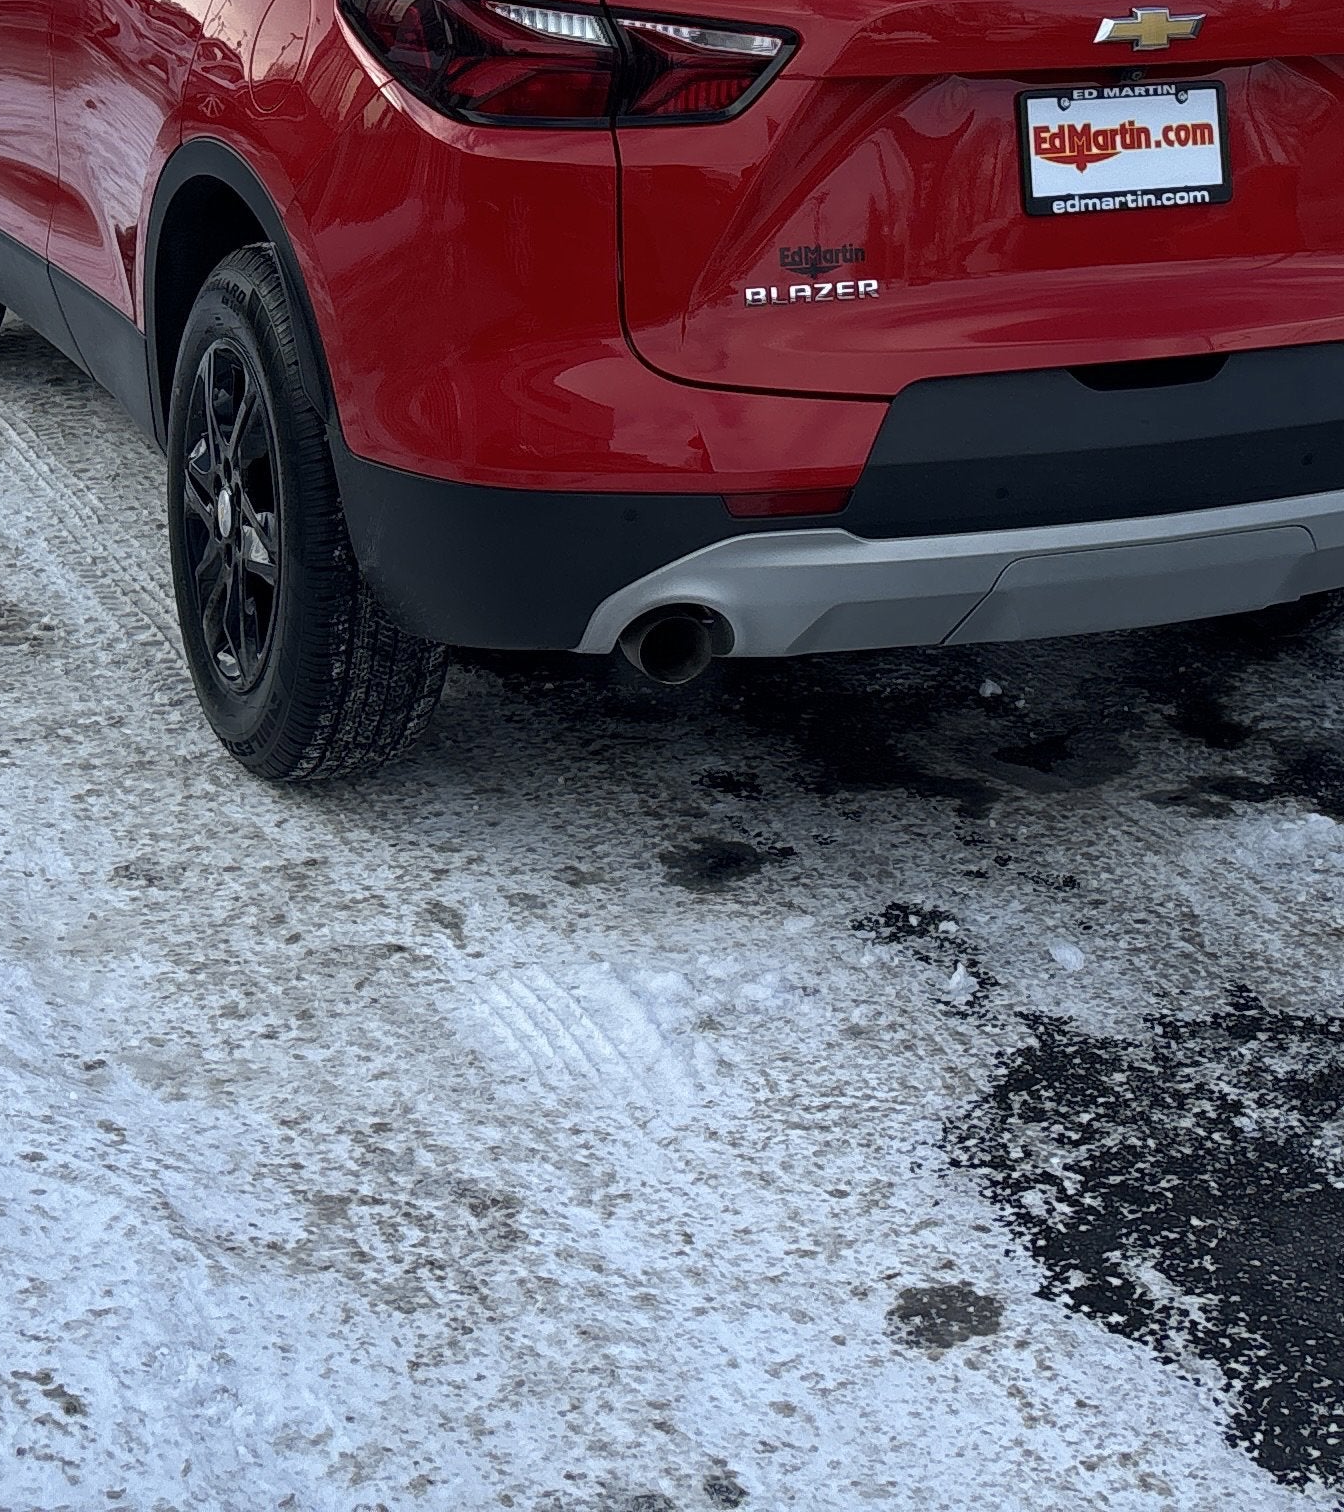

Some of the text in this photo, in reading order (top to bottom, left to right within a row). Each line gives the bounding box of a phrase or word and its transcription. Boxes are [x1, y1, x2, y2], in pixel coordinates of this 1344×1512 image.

[1073, 84, 1177, 100] ED MARTIN
[1032, 119, 1215, 156] EdMartin.com
[1052, 190, 1210, 214] edmartin.com
[779, 242, 866, 268] EdMartin
[745, 279, 880, 307] BLAZER
